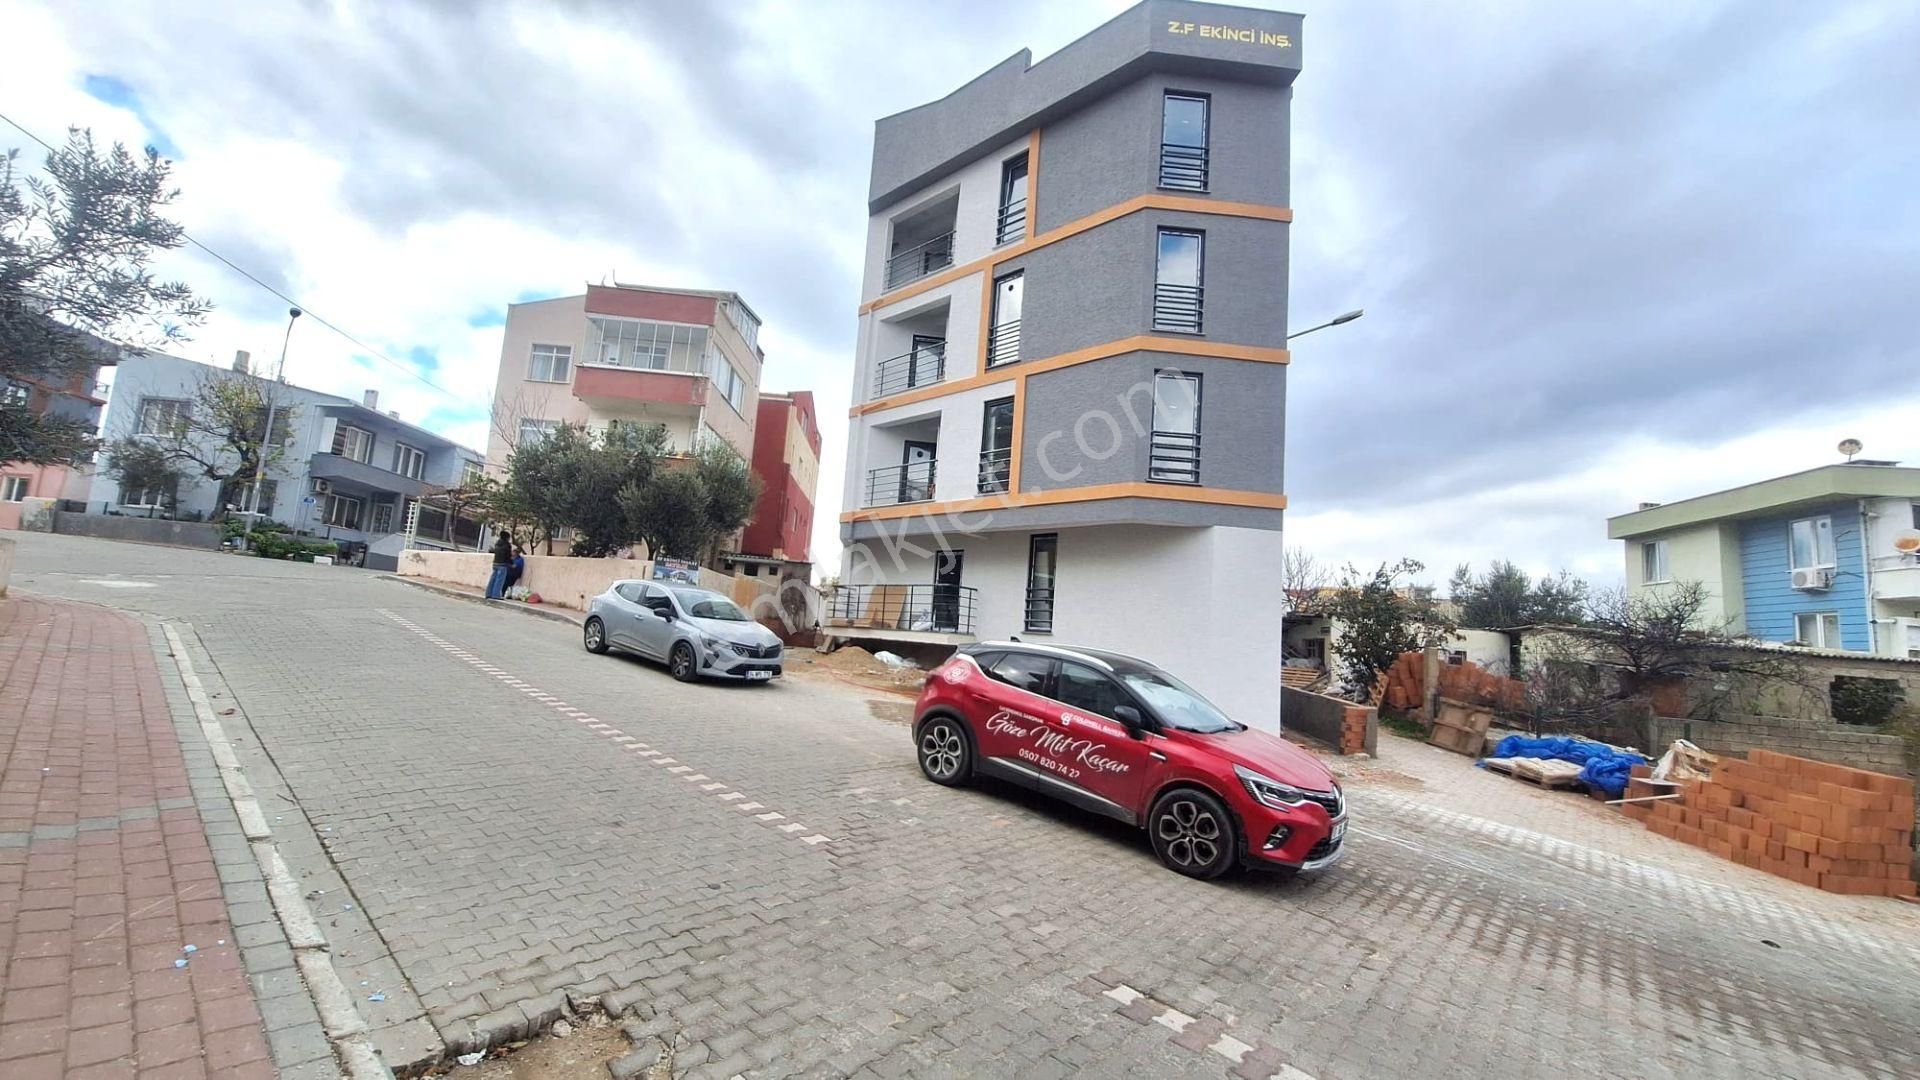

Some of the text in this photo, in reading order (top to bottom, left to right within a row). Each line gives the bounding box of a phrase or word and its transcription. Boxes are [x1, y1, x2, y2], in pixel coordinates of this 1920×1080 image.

[1167, 21, 1195, 35] Z.F
[1199, 25, 1255, 43] EKİNCİ
[986, 711, 1028, 737] Göze
[1029, 725, 1072, 758] Mit
[1070, 740, 1130, 773] Kaçar
[1018, 748, 1040, 762] 0507
[1040, 756, 1056, 770] 820
[1057, 763, 1068, 775] 74
